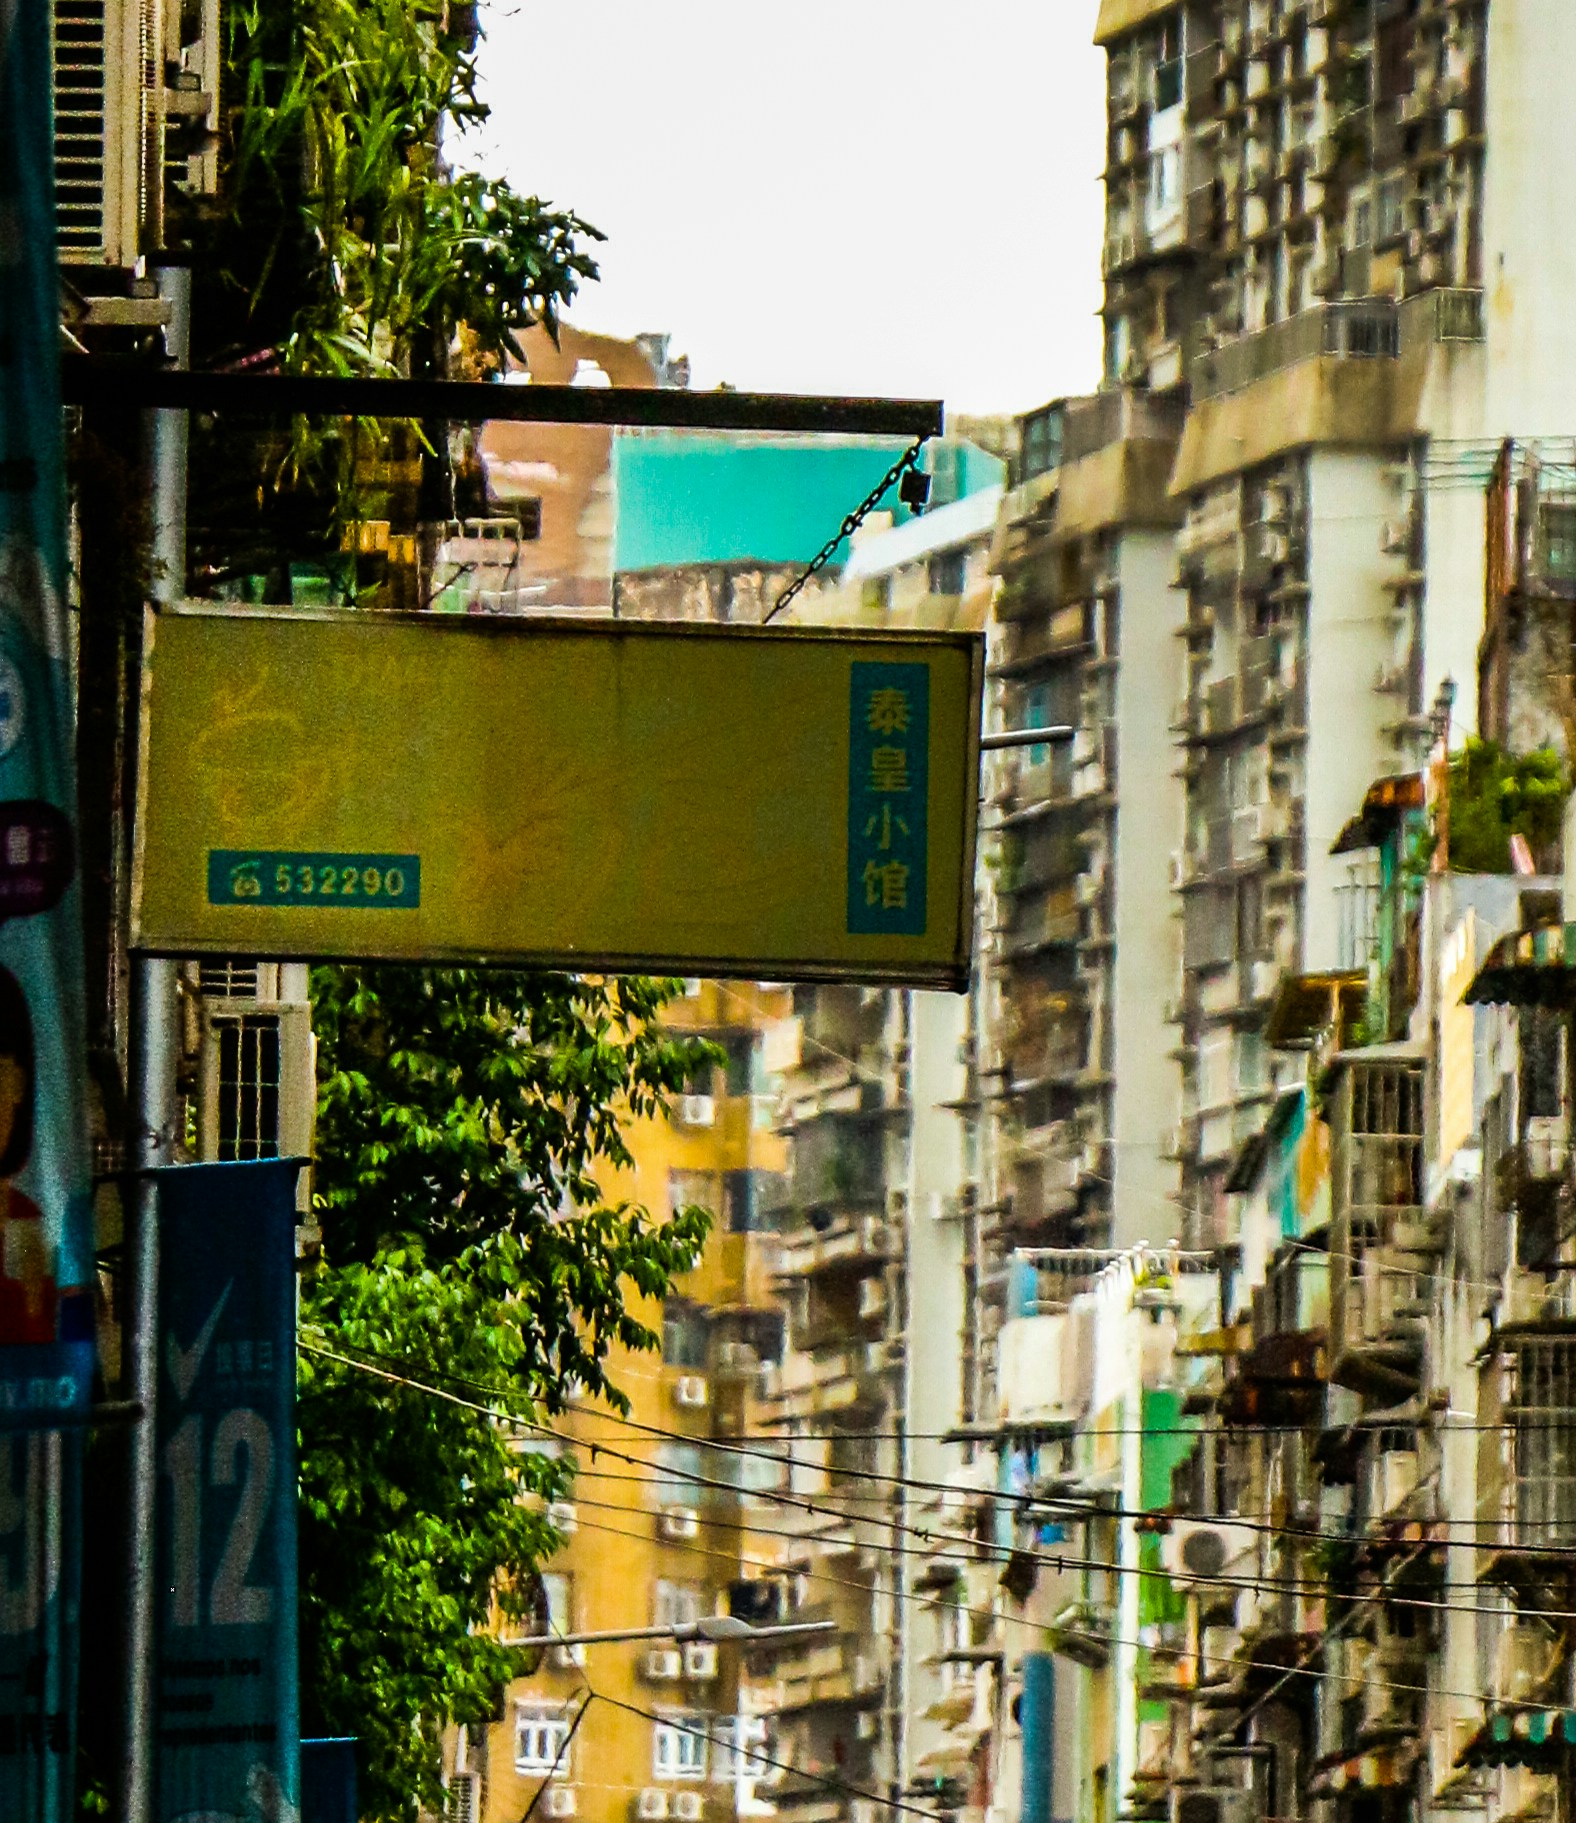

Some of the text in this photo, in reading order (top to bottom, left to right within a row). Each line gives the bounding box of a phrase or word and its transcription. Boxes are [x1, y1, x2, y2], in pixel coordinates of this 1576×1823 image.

[274, 863, 406, 897] 532290
[862, 684, 911, 911] 泰皇小馆
[162, 1407, 275, 1627] 12
